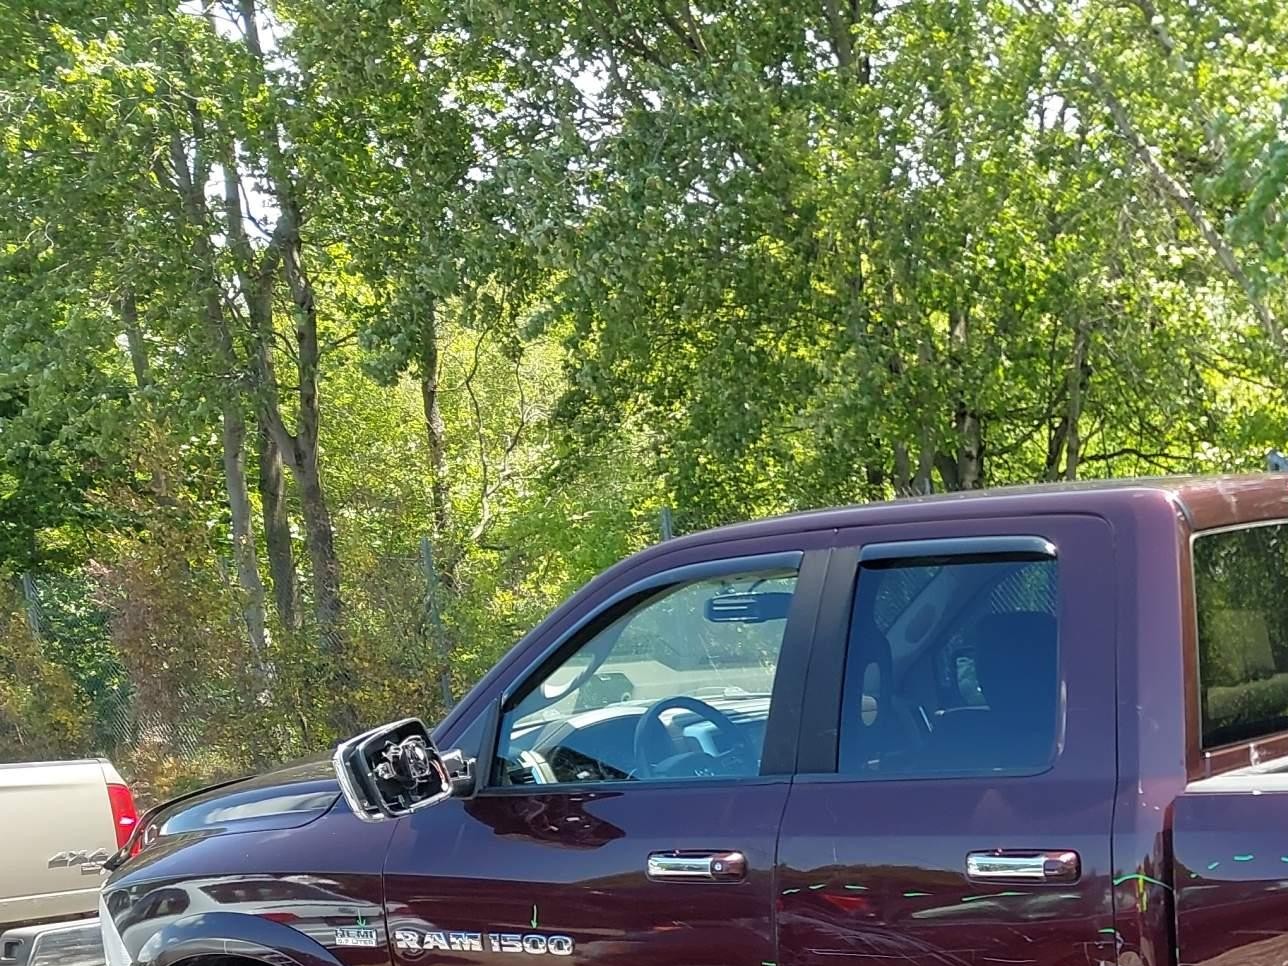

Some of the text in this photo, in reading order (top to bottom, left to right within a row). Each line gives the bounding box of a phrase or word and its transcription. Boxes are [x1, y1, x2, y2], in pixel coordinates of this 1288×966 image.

[335, 927, 376, 938] HEMI
[394, 930, 573, 955] RAM 1500
